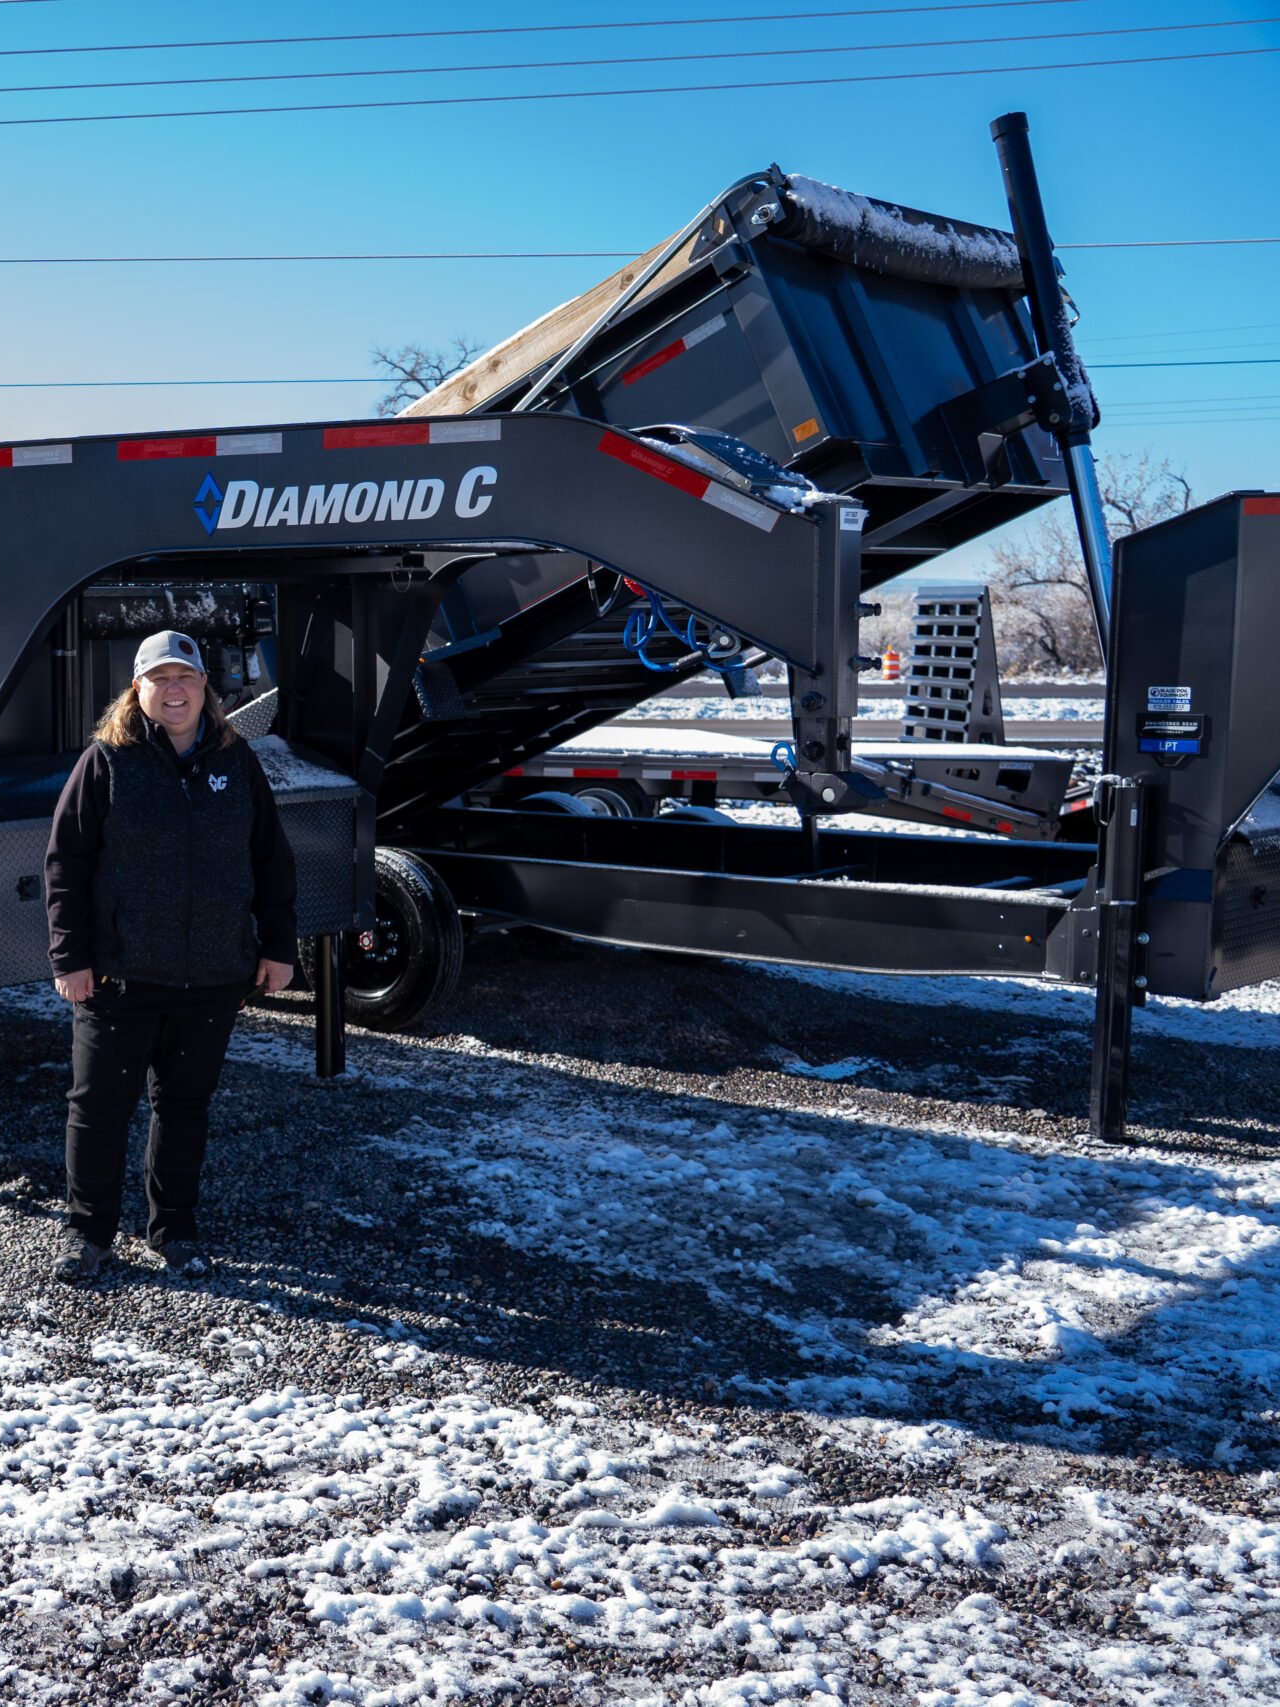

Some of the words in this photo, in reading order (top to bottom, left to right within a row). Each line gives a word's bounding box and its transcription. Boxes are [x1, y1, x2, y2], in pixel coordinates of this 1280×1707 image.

[217, 479, 446, 529] DIAMOND
[455, 465, 498, 519] C
[1159, 741, 1179, 751] LPT
